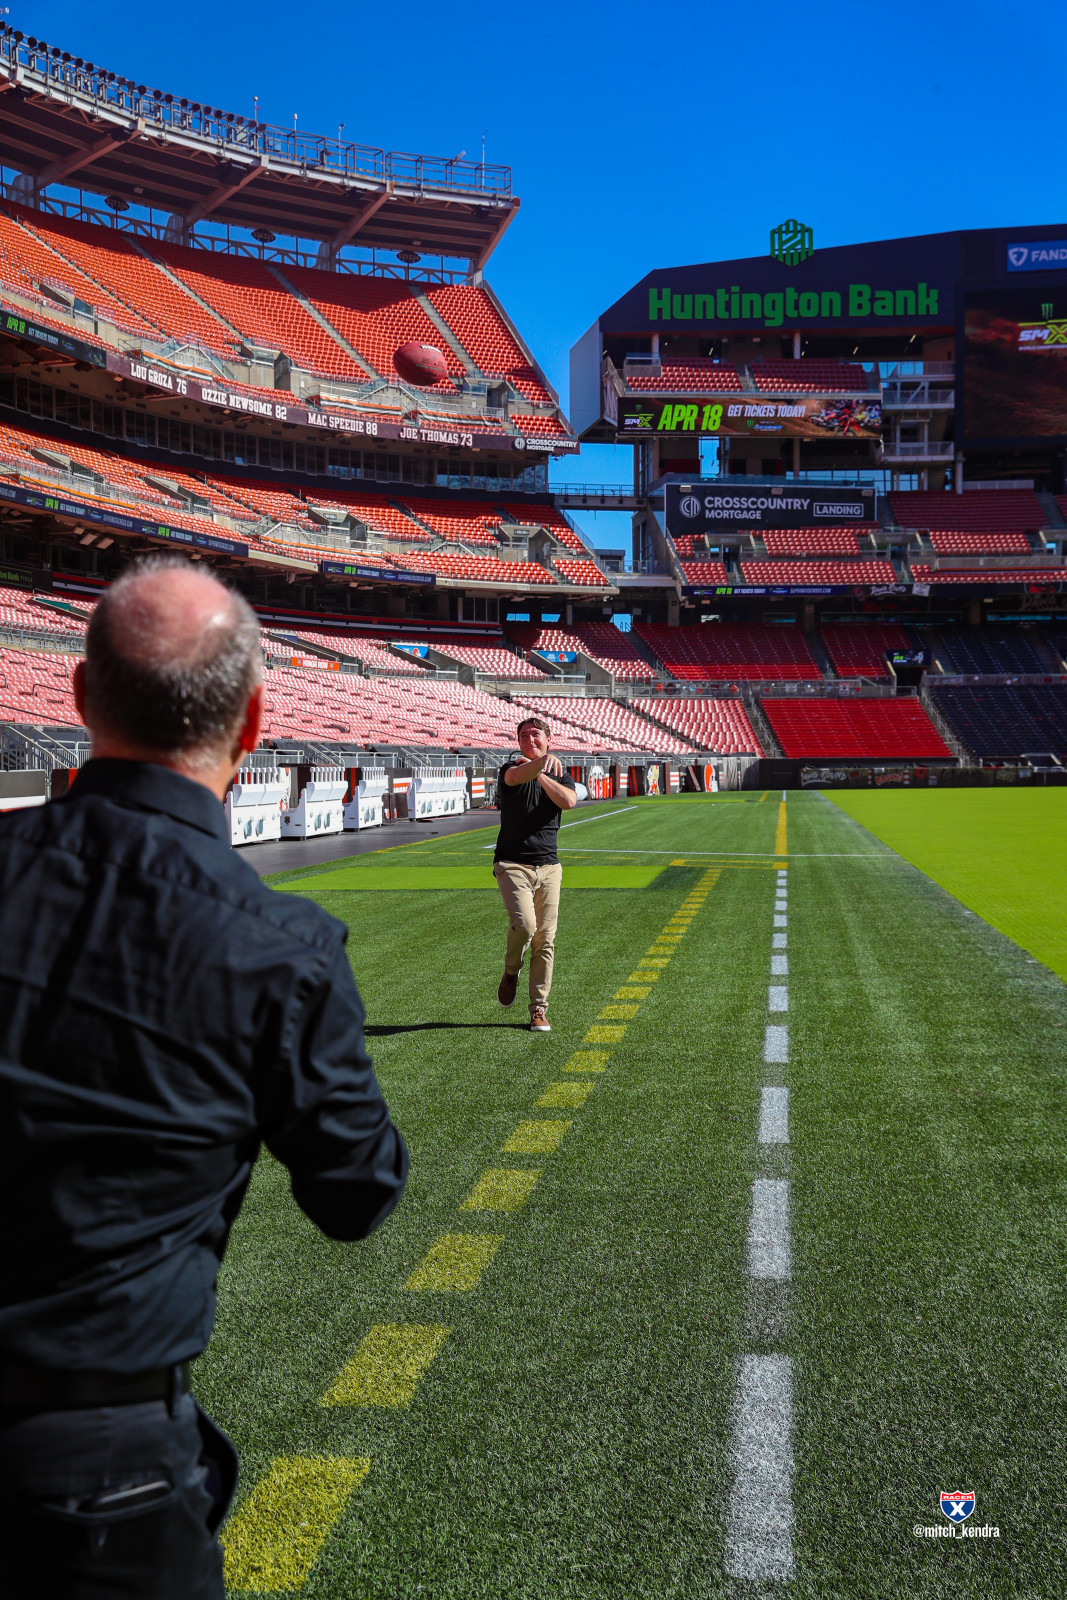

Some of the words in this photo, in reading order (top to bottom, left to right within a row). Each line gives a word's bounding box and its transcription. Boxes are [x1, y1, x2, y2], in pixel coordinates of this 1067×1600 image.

[649, 286, 841, 327] Huntington
[849, 283, 938, 316] Bank
[6, 316, 18, 331] APR
[18, 321, 26, 334] 18
[130, 362, 147, 379] LOU
[148, 367, 173, 390] GROZA
[176, 378, 187, 395] 76
[201, 388, 227, 405] OZZIE
[229, 394, 272, 416] NEWSOME
[275, 405, 287, 420] 82
[307, 412, 327, 427] MAC
[328, 415, 364, 433] SPEEDIE
[365, 422, 378, 436] 88
[624, 415, 652, 427] SMX
[657, 404, 699, 431] APR
[701, 404, 724, 431] 18
[727, 404, 742, 417] GET
[744, 404, 776, 417] TICKETS
[777, 405, 806, 417] TODAY!
[400, 427, 418, 440] JOE
[420, 429, 459, 444] THOMAS
[460, 433, 473, 447] 73
[526, 438, 577, 448] CROSSCOUNTRY
[526, 444, 554, 452] MORTGAGE
[704, 496, 810, 510] CROSSCOUNTRY
[815, 505, 861, 515] LANDING
[705, 509, 761, 519] MORTGAGE
